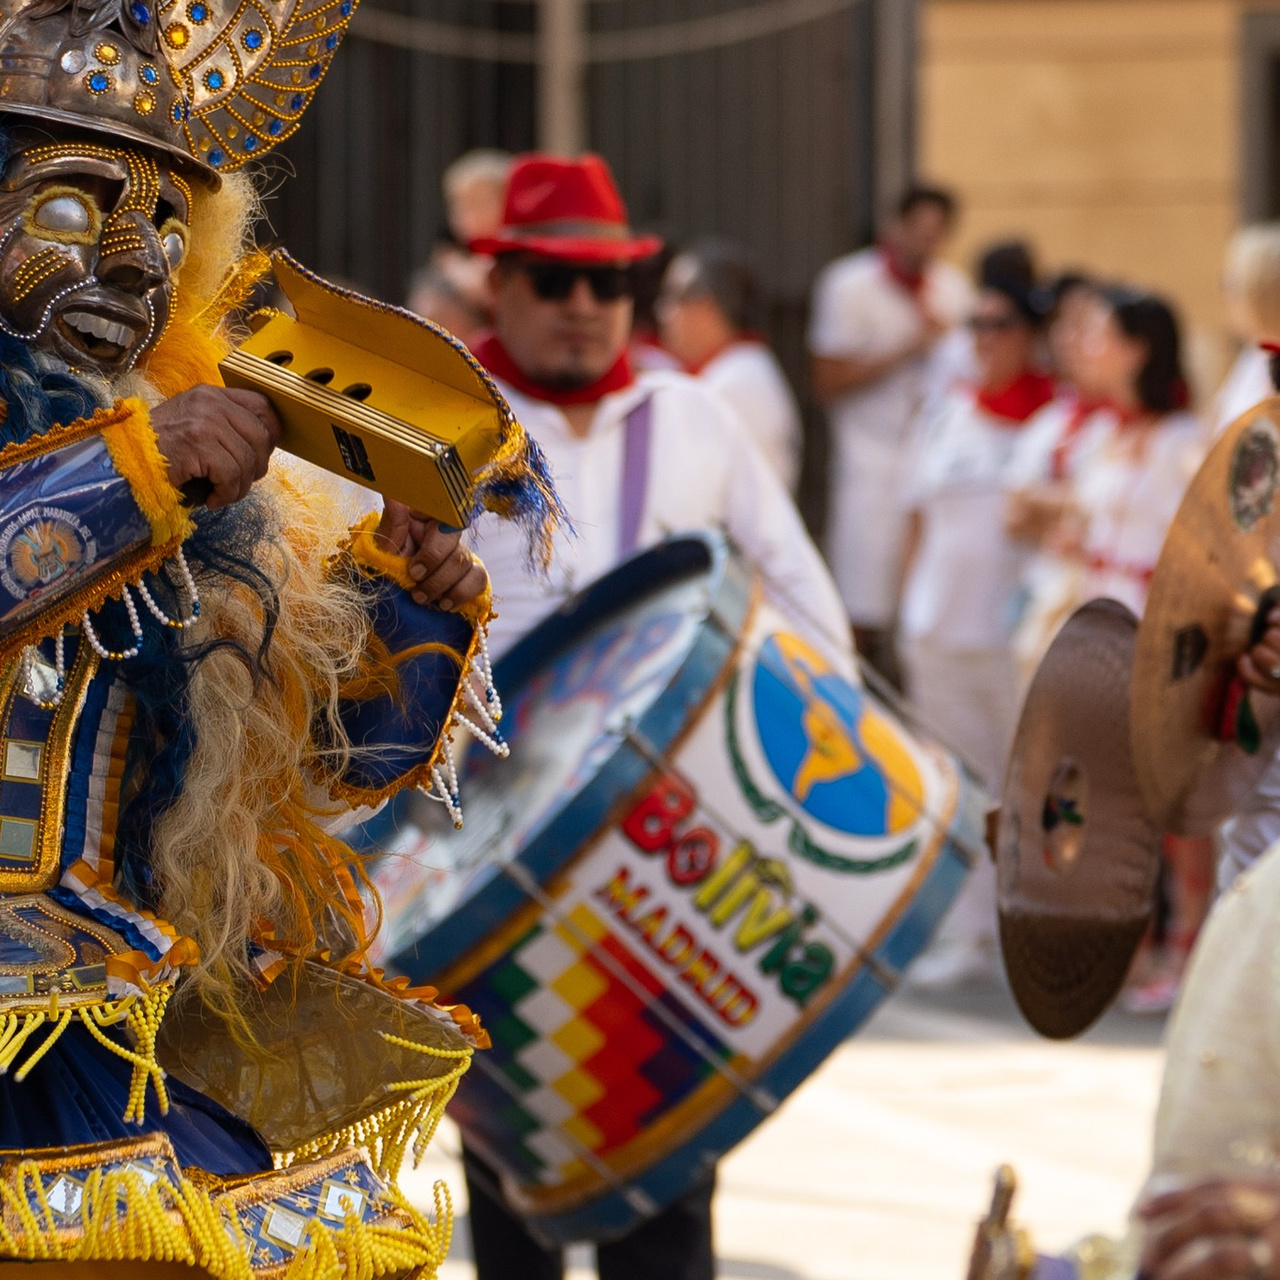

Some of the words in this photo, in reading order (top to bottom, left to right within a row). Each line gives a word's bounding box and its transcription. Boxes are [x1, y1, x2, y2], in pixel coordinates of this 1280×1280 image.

[43, 506, 81, 527] MARAVILLA
[595, 864, 762, 1029] MADRID
[622, 766, 837, 1007] Bolivia
